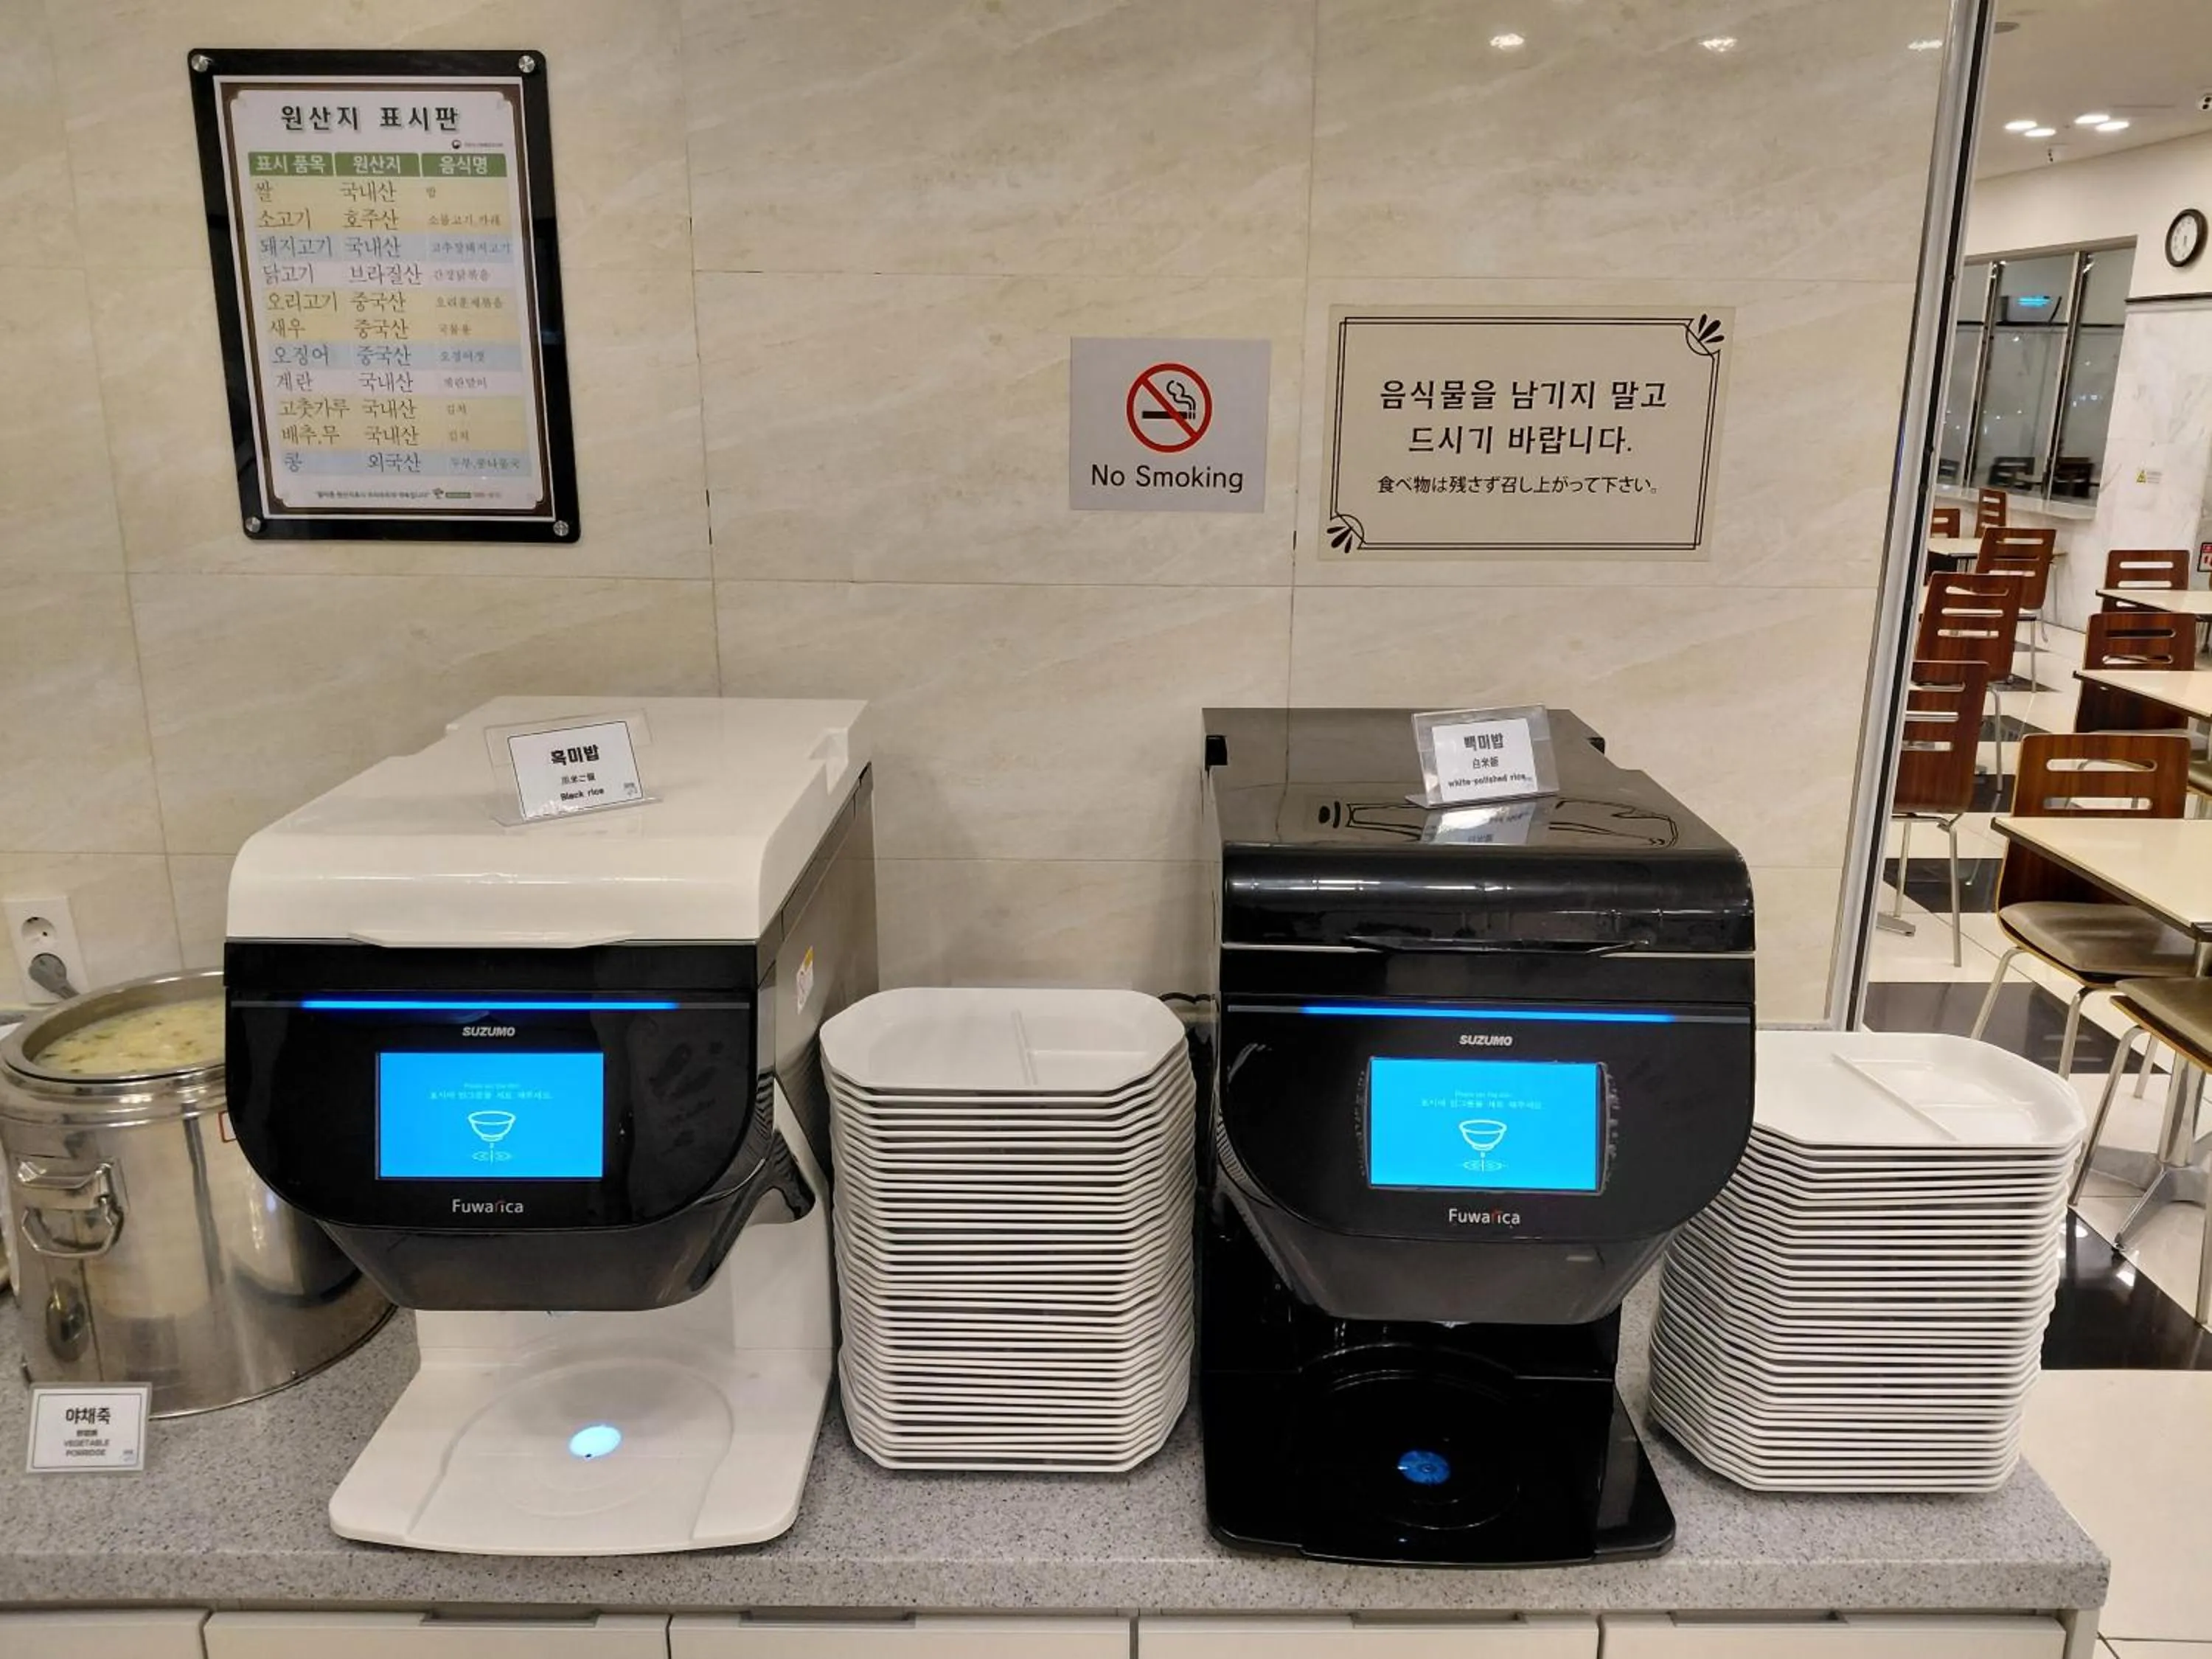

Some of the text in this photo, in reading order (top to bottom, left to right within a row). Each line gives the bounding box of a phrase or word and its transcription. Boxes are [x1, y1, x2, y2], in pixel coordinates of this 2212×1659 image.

[281, 106, 459, 131] 원산지 표시판
[255, 154, 326, 175] 표시 품목
[353, 153, 401, 175] 원산지
[439, 154, 488, 175] 음식명
[340, 180, 397, 203] 국내산
[258, 207, 312, 230] 소고기
[343, 208, 400, 232] 호주산
[260, 236, 333, 258] 돼지고기
[345, 235, 400, 259] 국내산
[263, 265, 315, 286] 닭고기
[349, 263, 422, 287] 브라질산
[267, 291, 338, 313] 오리고기
[350, 291, 406, 315] 중국산
[271, 318, 305, 338] 새우
[354, 317, 408, 341] 중국산
[272, 346, 330, 366] 오징어
[356, 344, 411, 367] 중국산
[276, 372, 313, 392] 계란
[358, 371, 414, 394] 국내산
[1380, 379, 1668, 410] 음식물을 남기지 말고
[278, 398, 351, 421] 고춧가루
[362, 397, 417, 420] 국내산
[366, 424, 420, 447] 국내산
[1408, 424, 1633, 456] 드시기 바랍니다.
[284, 451, 303, 473] 콩
[368, 451, 422, 473] 외국산
[1091, 463, 1243, 494] No Smoking
[1377, 474, 1658, 494] 食べ物は残さず召し上がって下さい。
[1464, 732, 1504, 751] 백미밥
[551, 744, 599, 766] 흑미밥
[560, 790, 585, 801] Black
[462, 1026, 516, 1037] SUZUMO
[1459, 1034, 1513, 1046] SUZUMO
[451, 1198, 525, 1214] Fuwarica
[1447, 1208, 1522, 1225] Fuwarica
[66, 1408, 111, 1425] 야채죽
